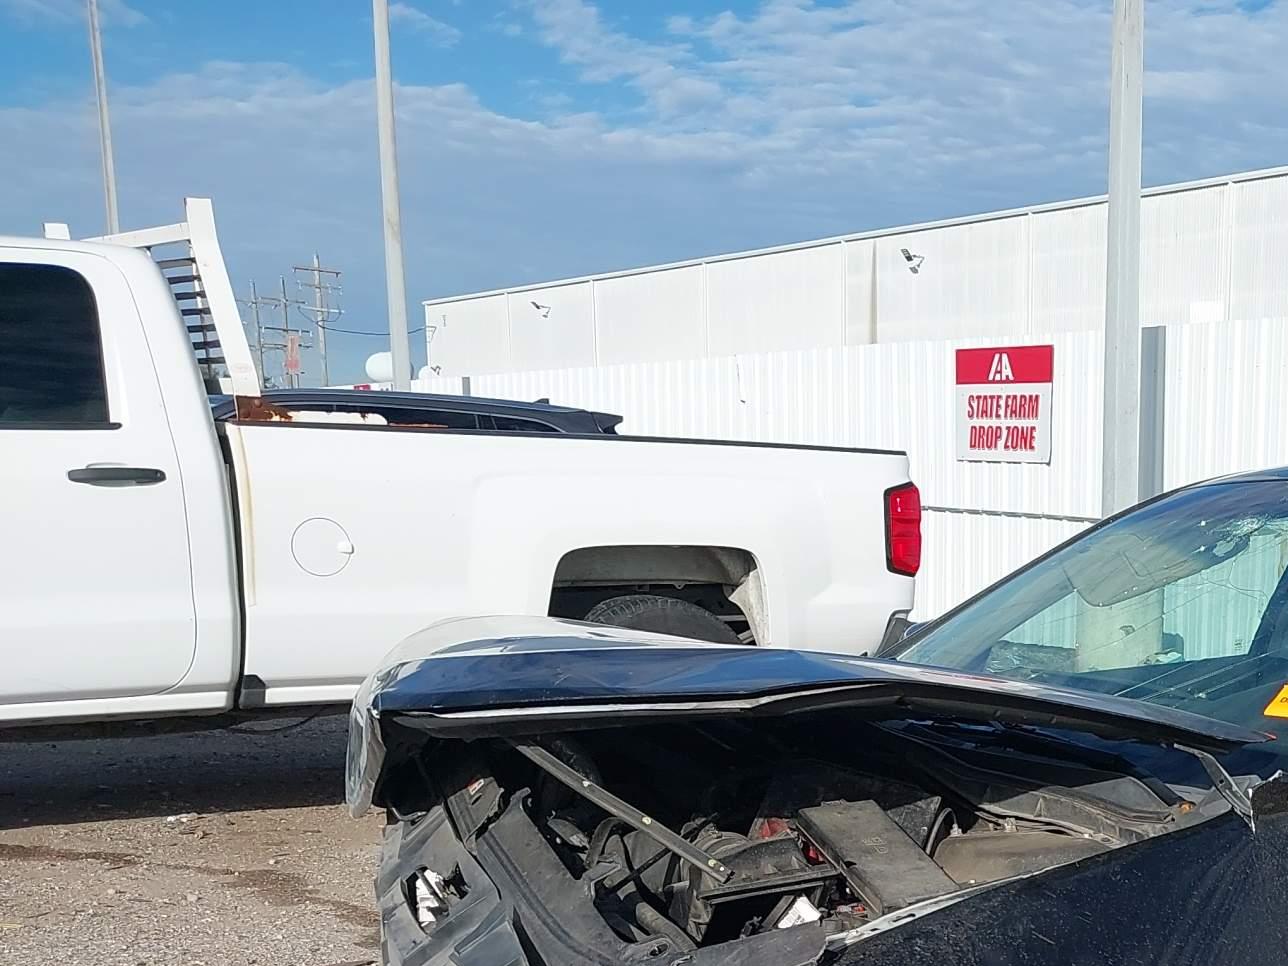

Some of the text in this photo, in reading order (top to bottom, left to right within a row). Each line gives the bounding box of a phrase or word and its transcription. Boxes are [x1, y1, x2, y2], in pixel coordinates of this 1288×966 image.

[967, 394, 1040, 420] STATE FARM
[970, 425, 1037, 451] DROP ZONE
